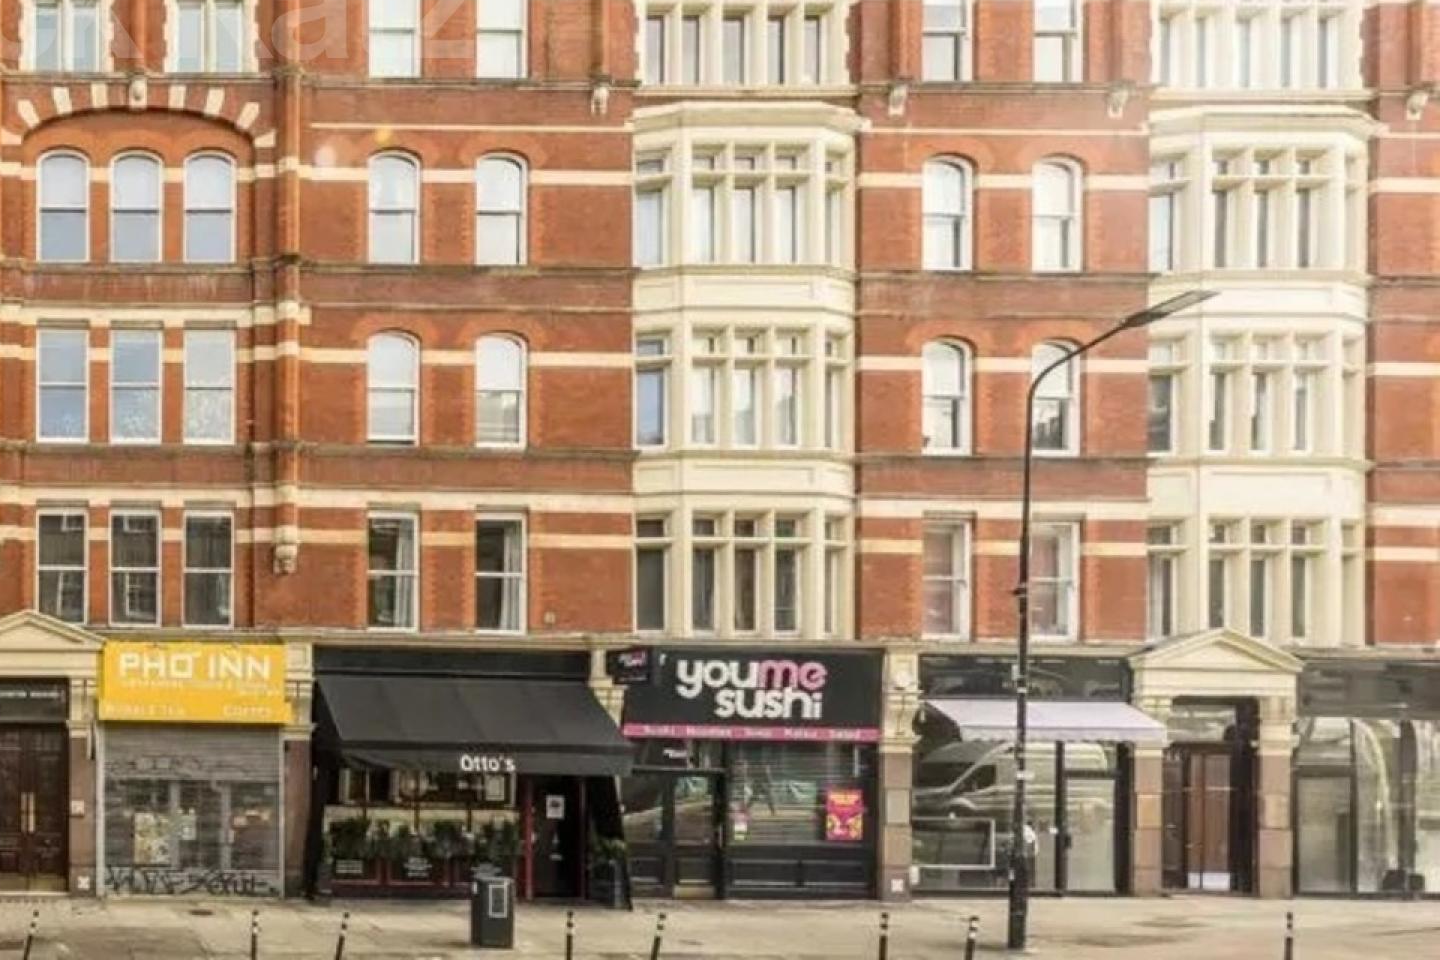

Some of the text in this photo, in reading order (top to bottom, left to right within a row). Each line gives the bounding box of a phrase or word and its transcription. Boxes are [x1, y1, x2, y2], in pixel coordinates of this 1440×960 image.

[207, 653, 272, 680] INN
[713, 688, 823, 720] sushi
[460, 754, 516, 773] Otto's
